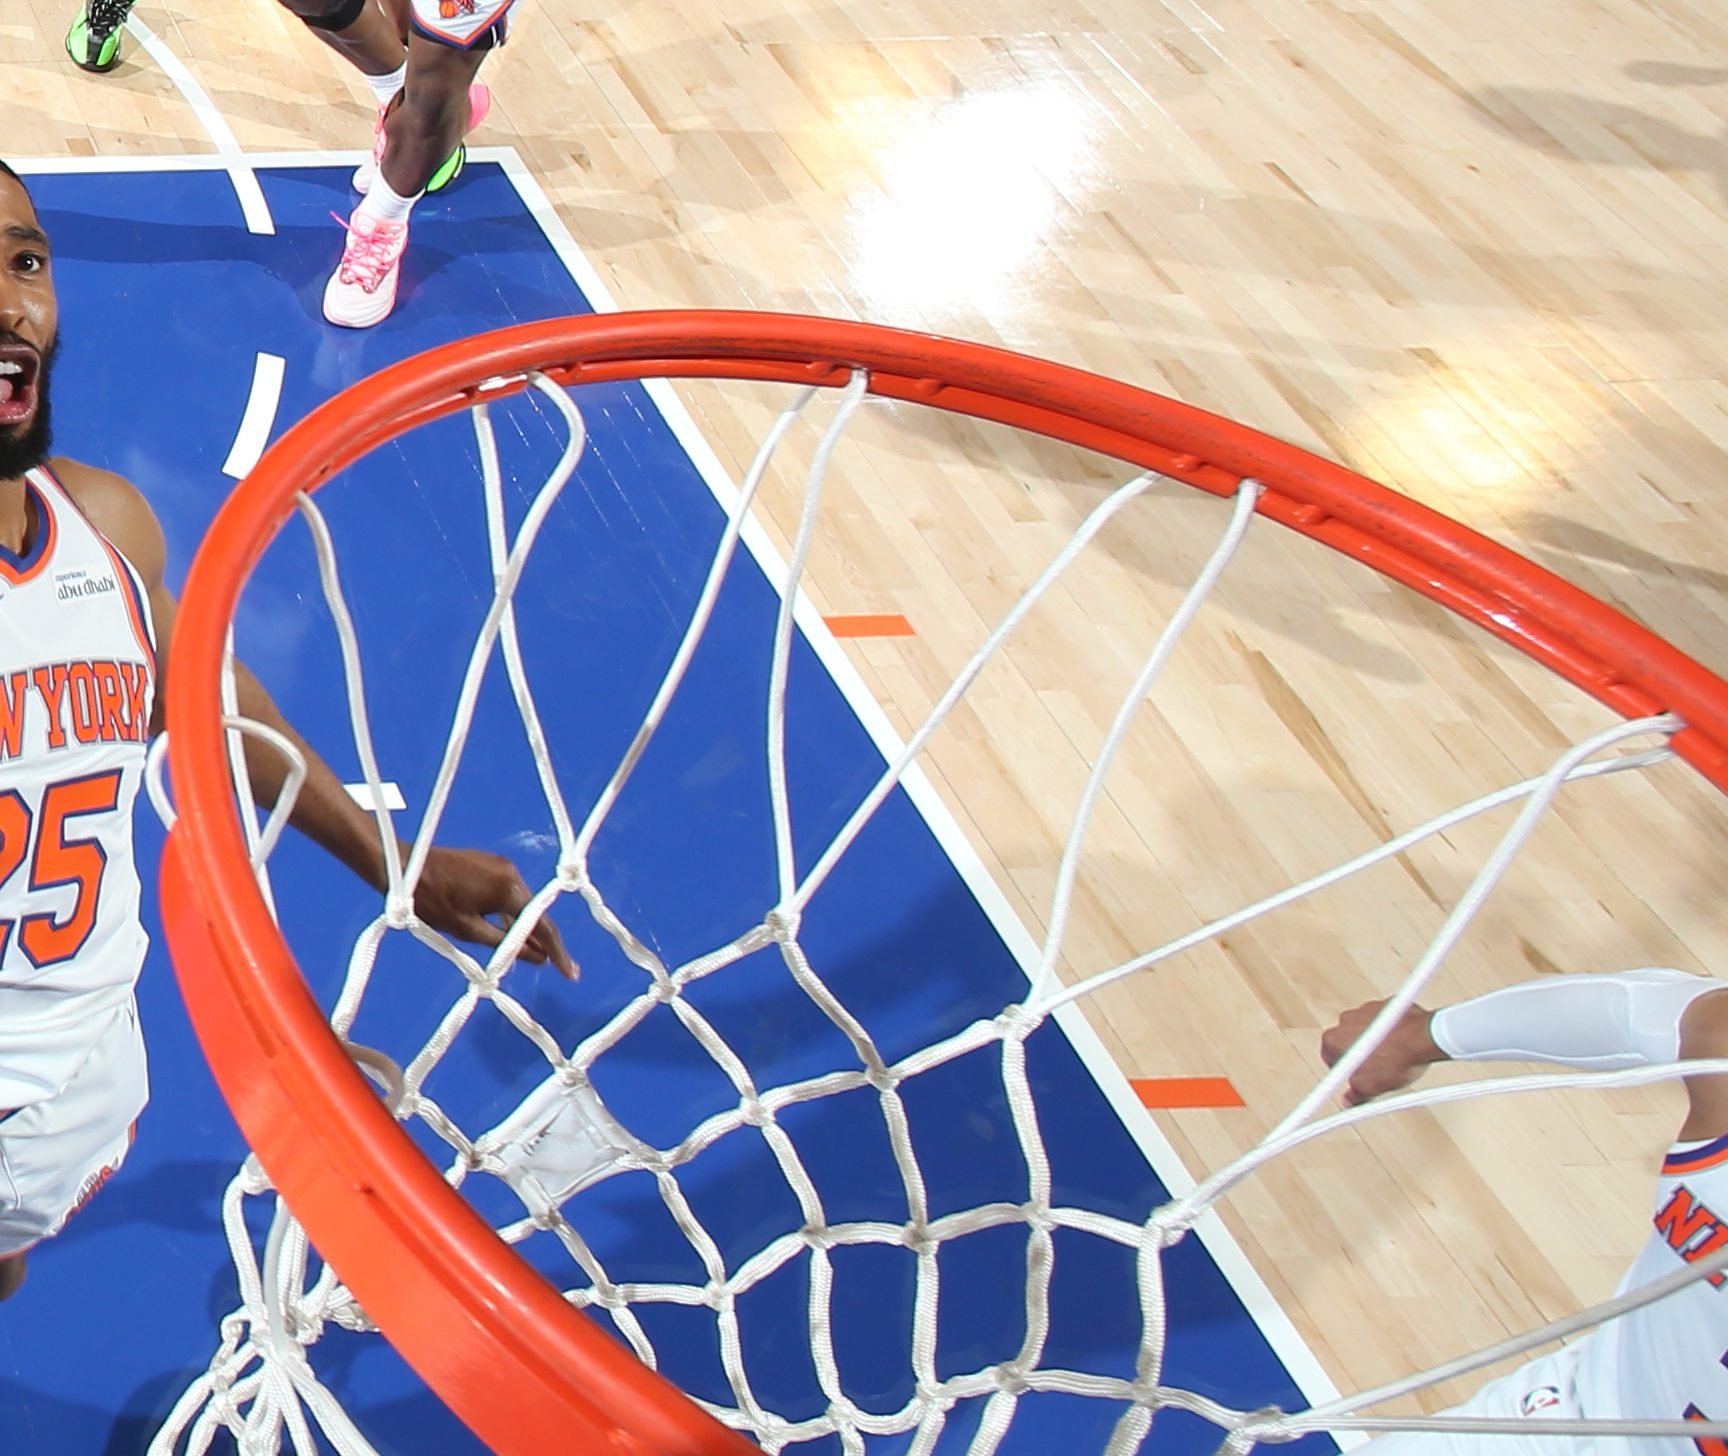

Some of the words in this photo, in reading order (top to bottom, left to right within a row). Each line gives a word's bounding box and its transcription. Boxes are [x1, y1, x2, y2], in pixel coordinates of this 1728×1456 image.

[57, 583, 83, 600] abu
[83, 575, 115, 595] dhabi
[32, 658, 148, 750] YORK
